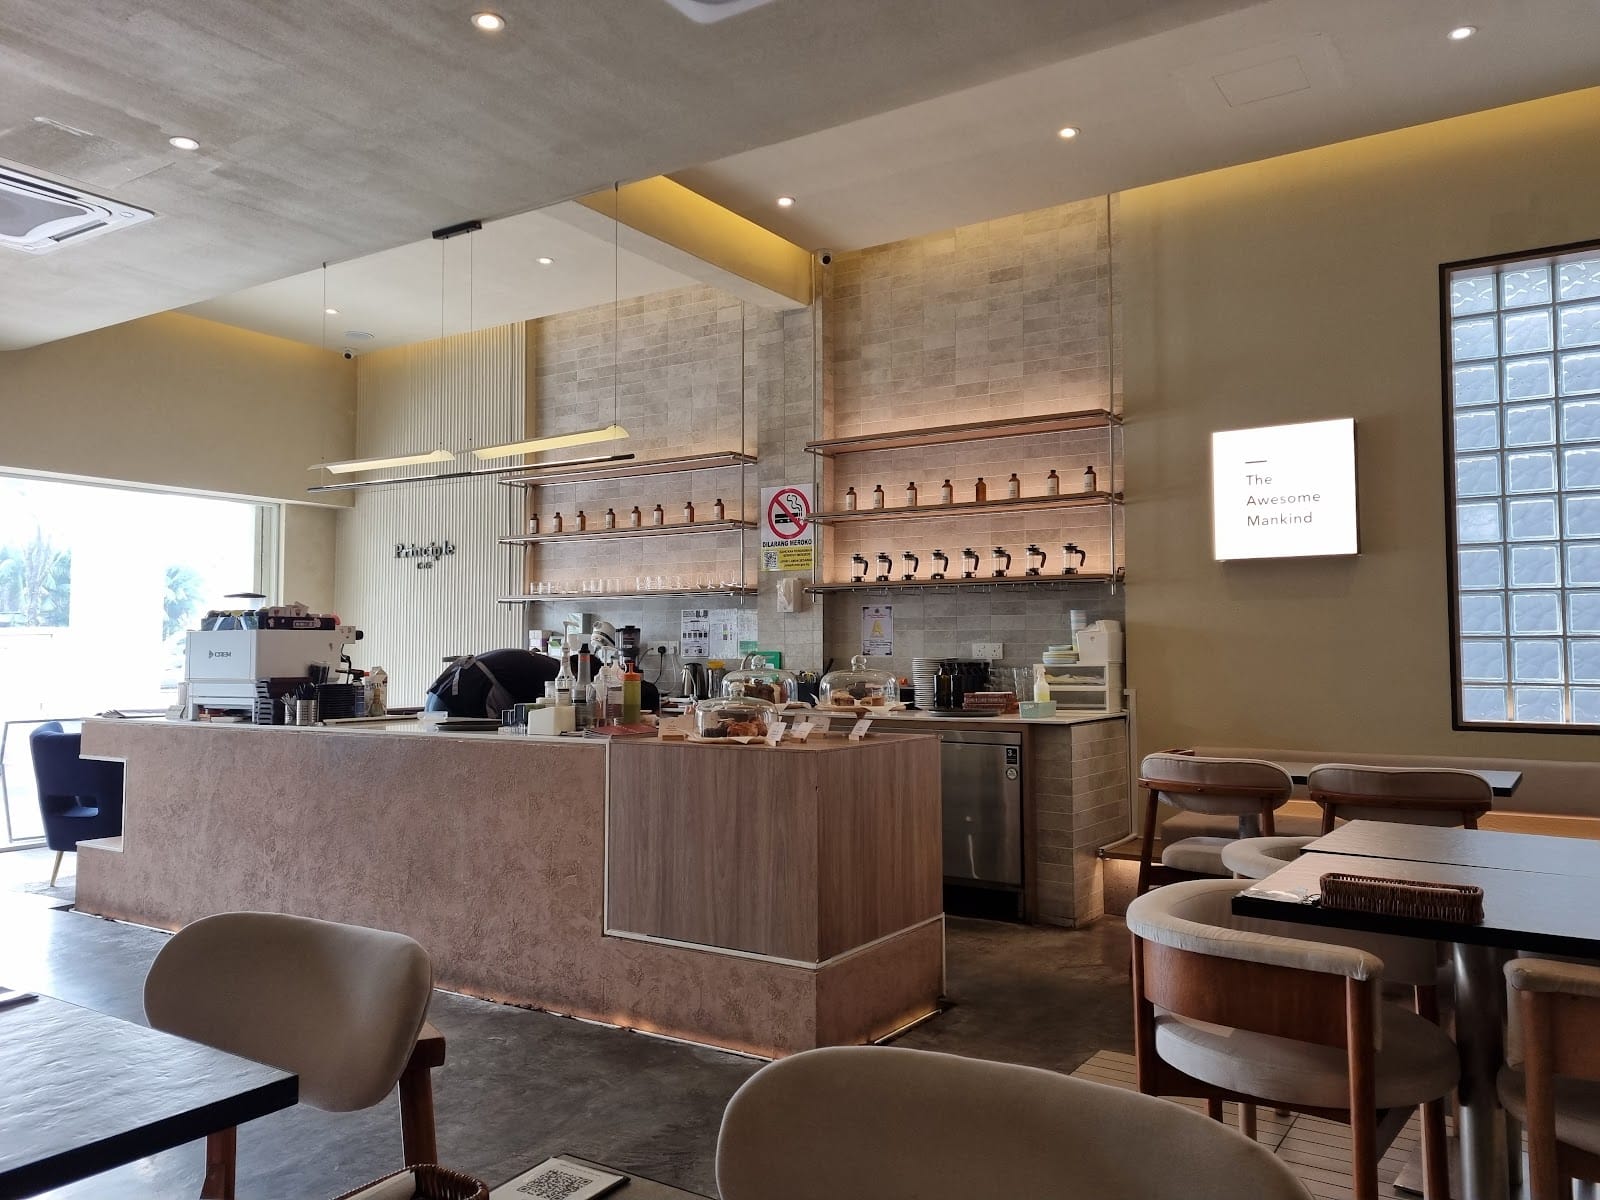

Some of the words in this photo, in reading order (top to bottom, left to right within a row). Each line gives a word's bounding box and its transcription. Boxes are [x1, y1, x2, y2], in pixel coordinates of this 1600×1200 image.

[1245, 474, 1273, 486] The
[1246, 493, 1321, 506] Awesome
[1247, 511, 1313, 527] Mankind
[394, 540, 456, 561] Principle
